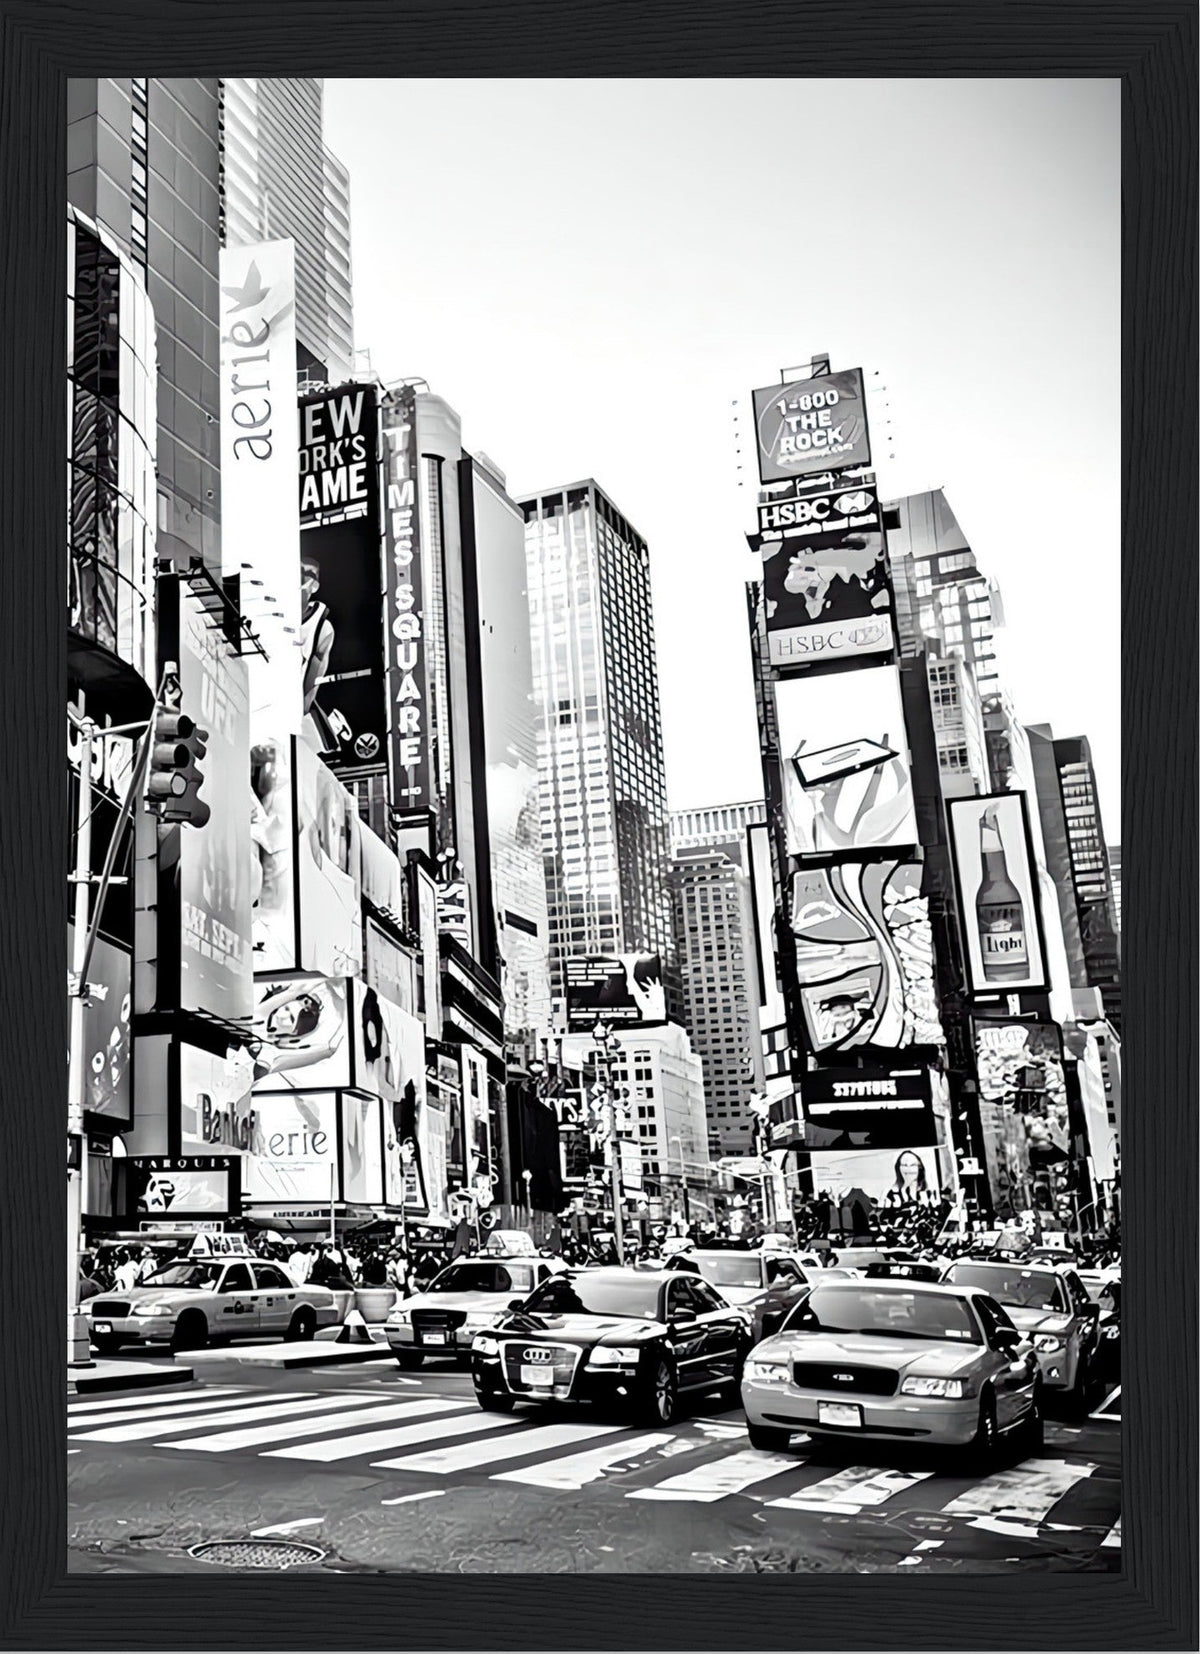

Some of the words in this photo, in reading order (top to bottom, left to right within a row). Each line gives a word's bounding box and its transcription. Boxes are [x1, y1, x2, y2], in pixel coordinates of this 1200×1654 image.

[230, 317, 272, 461] aerie
[305, 391, 364, 446] EW
[780, 425, 844, 453] ROCK
[785, 408, 832, 433] THE
[298, 434, 366, 476] ORK'S
[301, 461, 368, 512] AME
[385, 423, 414, 566] TIMES
[761, 498, 831, 529] HSBC
[777, 630, 844, 656] HSBC
[392, 583, 422, 767] SQUARE
